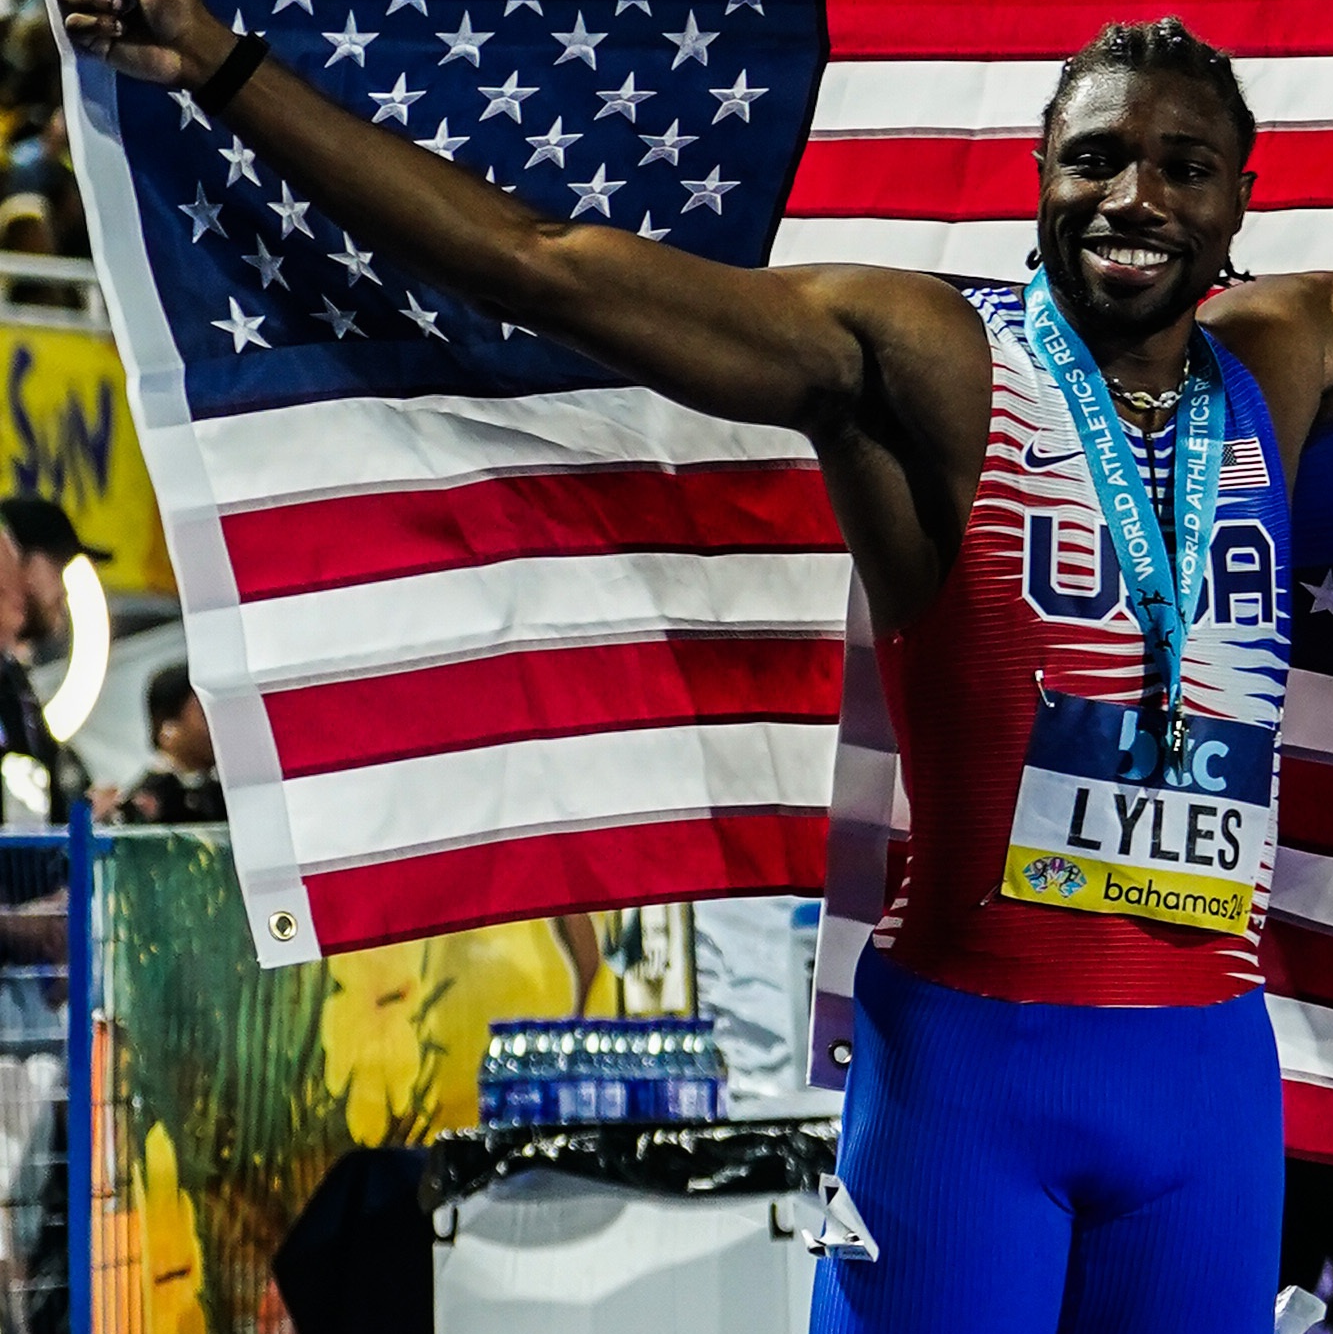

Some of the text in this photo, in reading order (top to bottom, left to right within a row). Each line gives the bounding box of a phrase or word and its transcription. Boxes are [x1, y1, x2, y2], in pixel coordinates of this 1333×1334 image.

[1034, 289, 1154, 581] WORLD ATHLETICS RELAYS
[1186, 393, 1212, 511] ATHLETICS
[1022, 507, 1277, 630] UA
[1180, 514, 1199, 595] WORLD
[1066, 787, 1243, 871] LYLES
